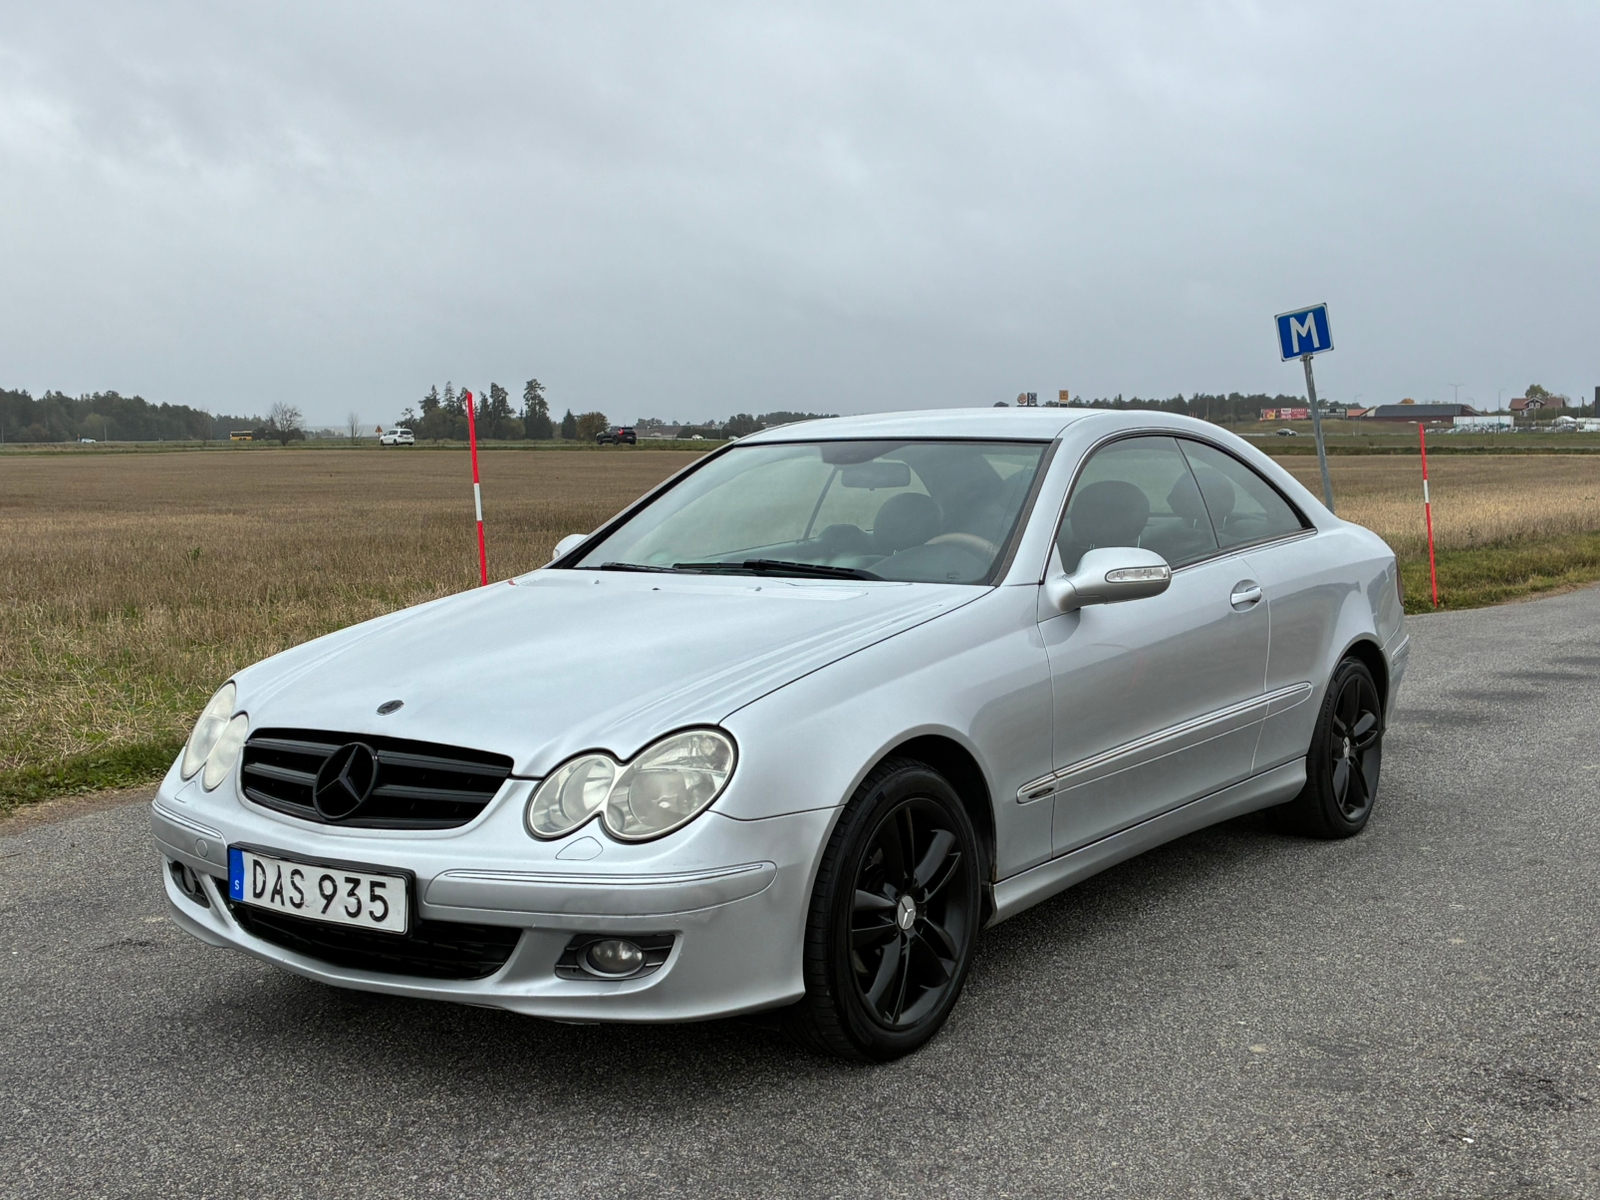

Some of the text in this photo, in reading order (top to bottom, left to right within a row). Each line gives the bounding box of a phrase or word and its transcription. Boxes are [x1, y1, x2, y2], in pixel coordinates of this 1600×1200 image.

[1289, 312, 1320, 354] M
[234, 879, 240, 891] S
[252, 858, 389, 923] DAS 935
